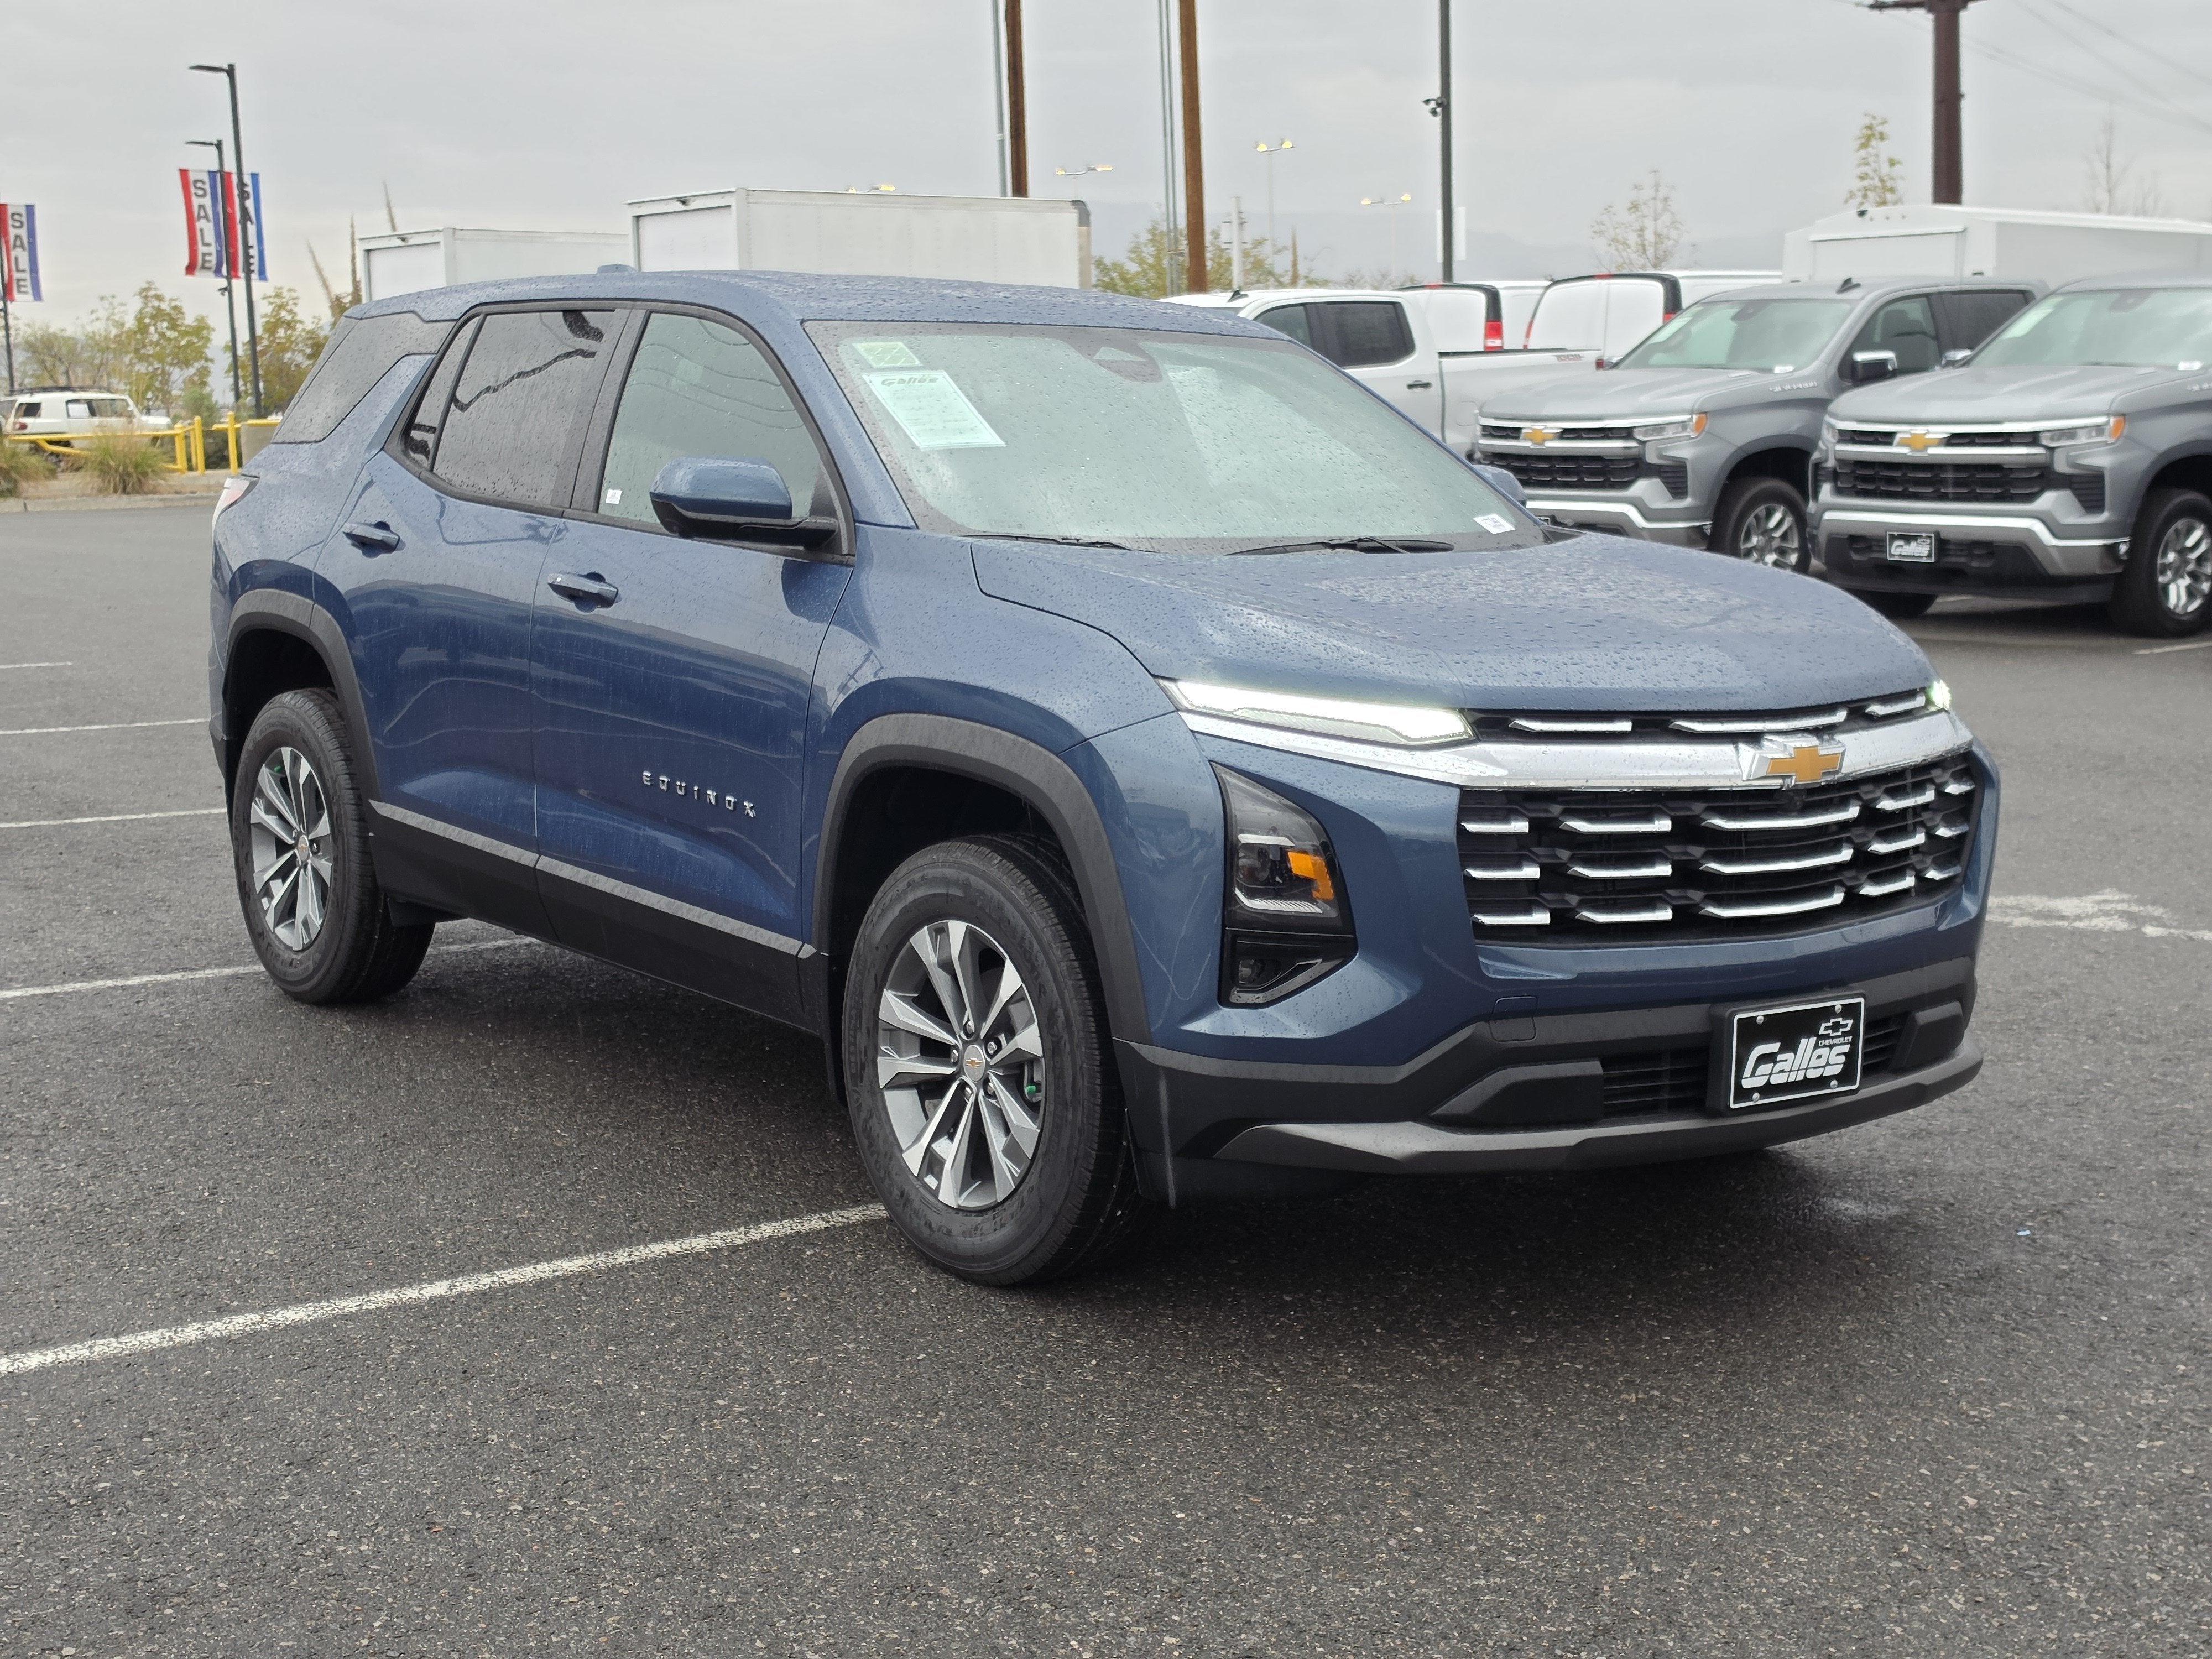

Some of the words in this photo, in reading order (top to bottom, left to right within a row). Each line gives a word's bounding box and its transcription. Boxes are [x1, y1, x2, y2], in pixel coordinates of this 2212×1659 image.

[192, 179, 212, 270] SALE
[11, 212, 29, 295] SALE
[1890, 539, 1931, 557] Galles
[642, 770, 757, 818] EQUINOX
[1741, 1037, 1850, 1089] Galles
[1818, 1036, 1853, 1046] CHEVROLET
